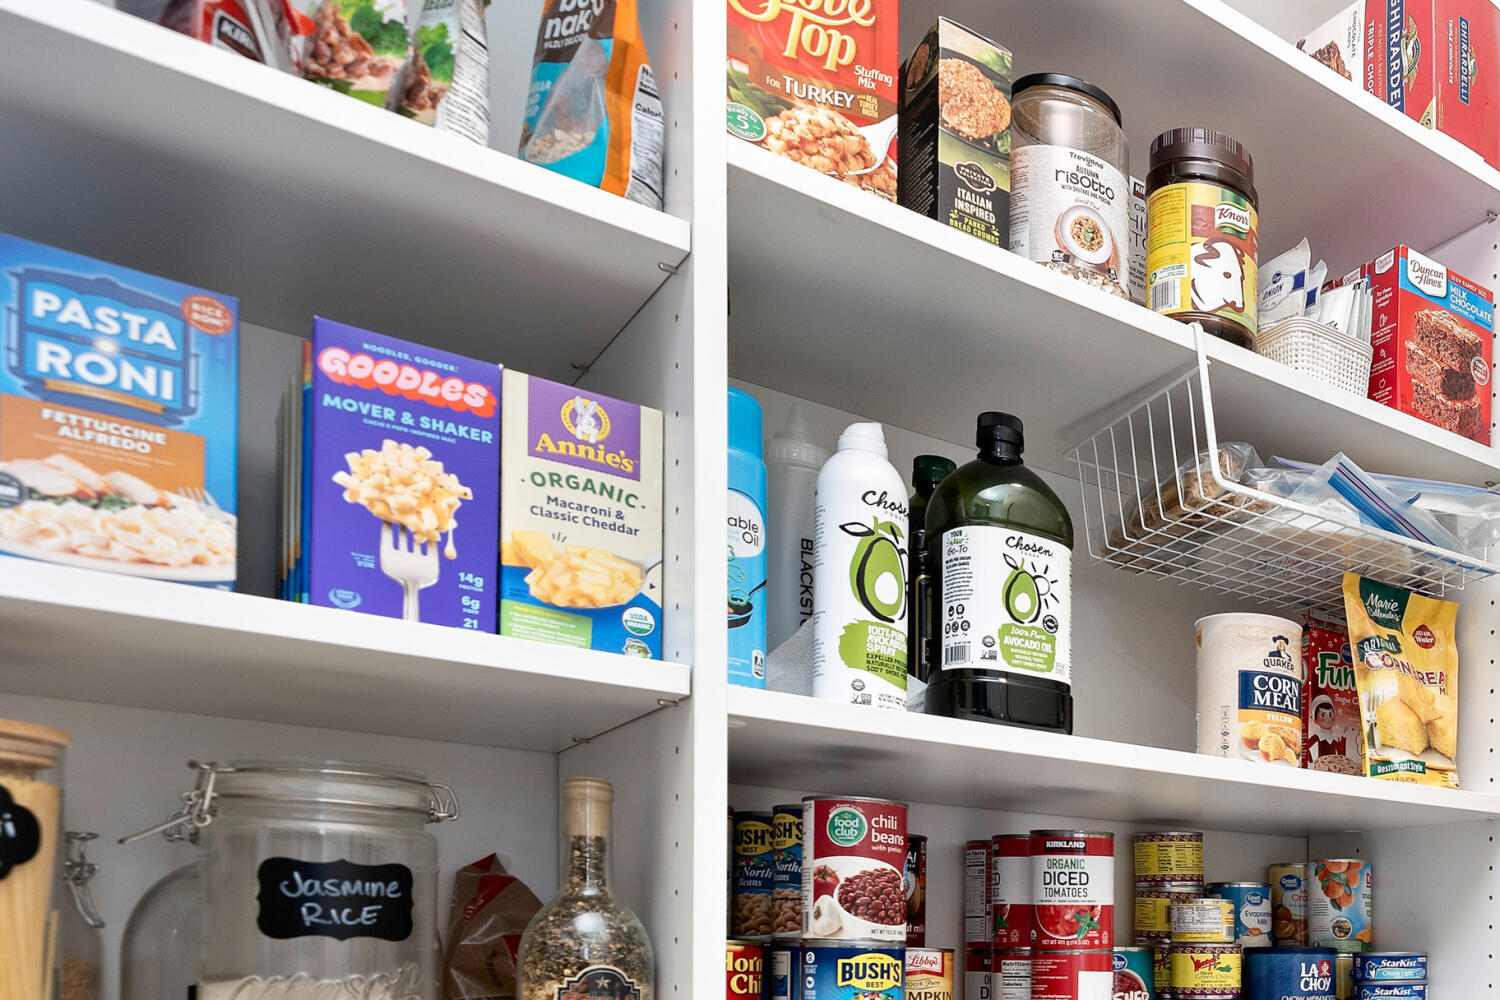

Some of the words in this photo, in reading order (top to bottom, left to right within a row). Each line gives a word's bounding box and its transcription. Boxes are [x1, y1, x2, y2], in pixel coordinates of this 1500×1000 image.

[780, 8, 857, 73] Top
[1367, 19, 1376, 61] TRIPLE
[1460, 20, 1468, 101] GHIRARDELLI
[853, 64, 893, 87] Stuffing
[857, 77, 877, 91] Mix
[766, 75, 781, 89] FOR
[782, 75, 855, 109] TURKEY
[736, 114, 752, 130] 5
[1076, 164, 1101, 180] AUTUMN
[1055, 168, 1115, 201] risotto
[957, 187, 993, 212] ITALIAN
[954, 198, 996, 224] INSPIRED
[1216, 206, 1250, 227] Knorr
[949, 219, 973, 237] BREAD
[963, 214, 987, 232] PANKO
[1410, 259, 1444, 280] Duncan
[1415, 273, 1443, 289] Hines
[1262, 282, 1284, 302] ONION
[1450, 285, 1468, 301] MILK
[1450, 296, 1492, 322] CHOCOLATE
[32, 289, 178, 351] PASTA
[36, 341, 175, 401] RONI
[320, 347, 492, 412] GOODLES
[41, 408, 167, 445] FETTUCCINE
[322, 394, 396, 421] MOVER
[400, 411, 415, 426] &
[419, 415, 492, 444] SHAKER
[57, 426, 152, 454] ALFREDO
[535, 433, 635, 473] Annie's
[530, 471, 639, 509] ORGANIC
[546, 495, 612, 518] Macaroni
[615, 510, 625, 521] &
[529, 505, 580, 524] Classic
[582, 516, 640, 536] Cheddar
[742, 531, 759, 547] Oil
[950, 530, 963, 538] YOUR
[1005, 536, 1053, 557] Chosen
[458, 571, 484, 588] 14g
[800, 537, 813, 625] BLACKST
[461, 595, 480, 611] 6g
[1366, 593, 1399, 612] Marie
[463, 617, 479, 629] 21
[629, 613, 649, 622] USDA
[1010, 626, 1029, 636] 100%
[1029, 630, 1046, 641] Pure
[1415, 634, 1434, 644] Water
[866, 643, 897, 657] SPRAY
[1003, 635, 1041, 651] AVOCADO
[1041, 642, 1053, 653] OIL
[1363, 638, 1399, 652] ORIGINAL
[1263, 657, 1295, 673] QUAKER
[1365, 651, 1411, 676] CORN
[1253, 675, 1299, 696] CORN
[1253, 690, 1299, 712] MEAL
[1266, 713, 1294, 724] YELLOW
[1409, 762, 1424, 775] Style
[834, 816, 859, 828] food
[871, 814, 898, 829] chili
[834, 826, 858, 837] club
[871, 828, 904, 846] beans
[1046, 858, 1085, 870] ORGANIC
[279, 871, 402, 898] Jasmine
[1043, 871, 1089, 886] DICED
[1044, 887, 1088, 898] TOMATOES
[300, 902, 383, 927] RICE
[905, 953, 939, 968] Libby's
[1380, 959, 1417, 968] StarKist
[841, 962, 901, 983] BUSH'S
[1301, 962, 1319, 978] LA
[866, 981, 884, 989] BEST
[1300, 977, 1331, 992] CHOY
[1374, 988, 1412, 996] StarKist
